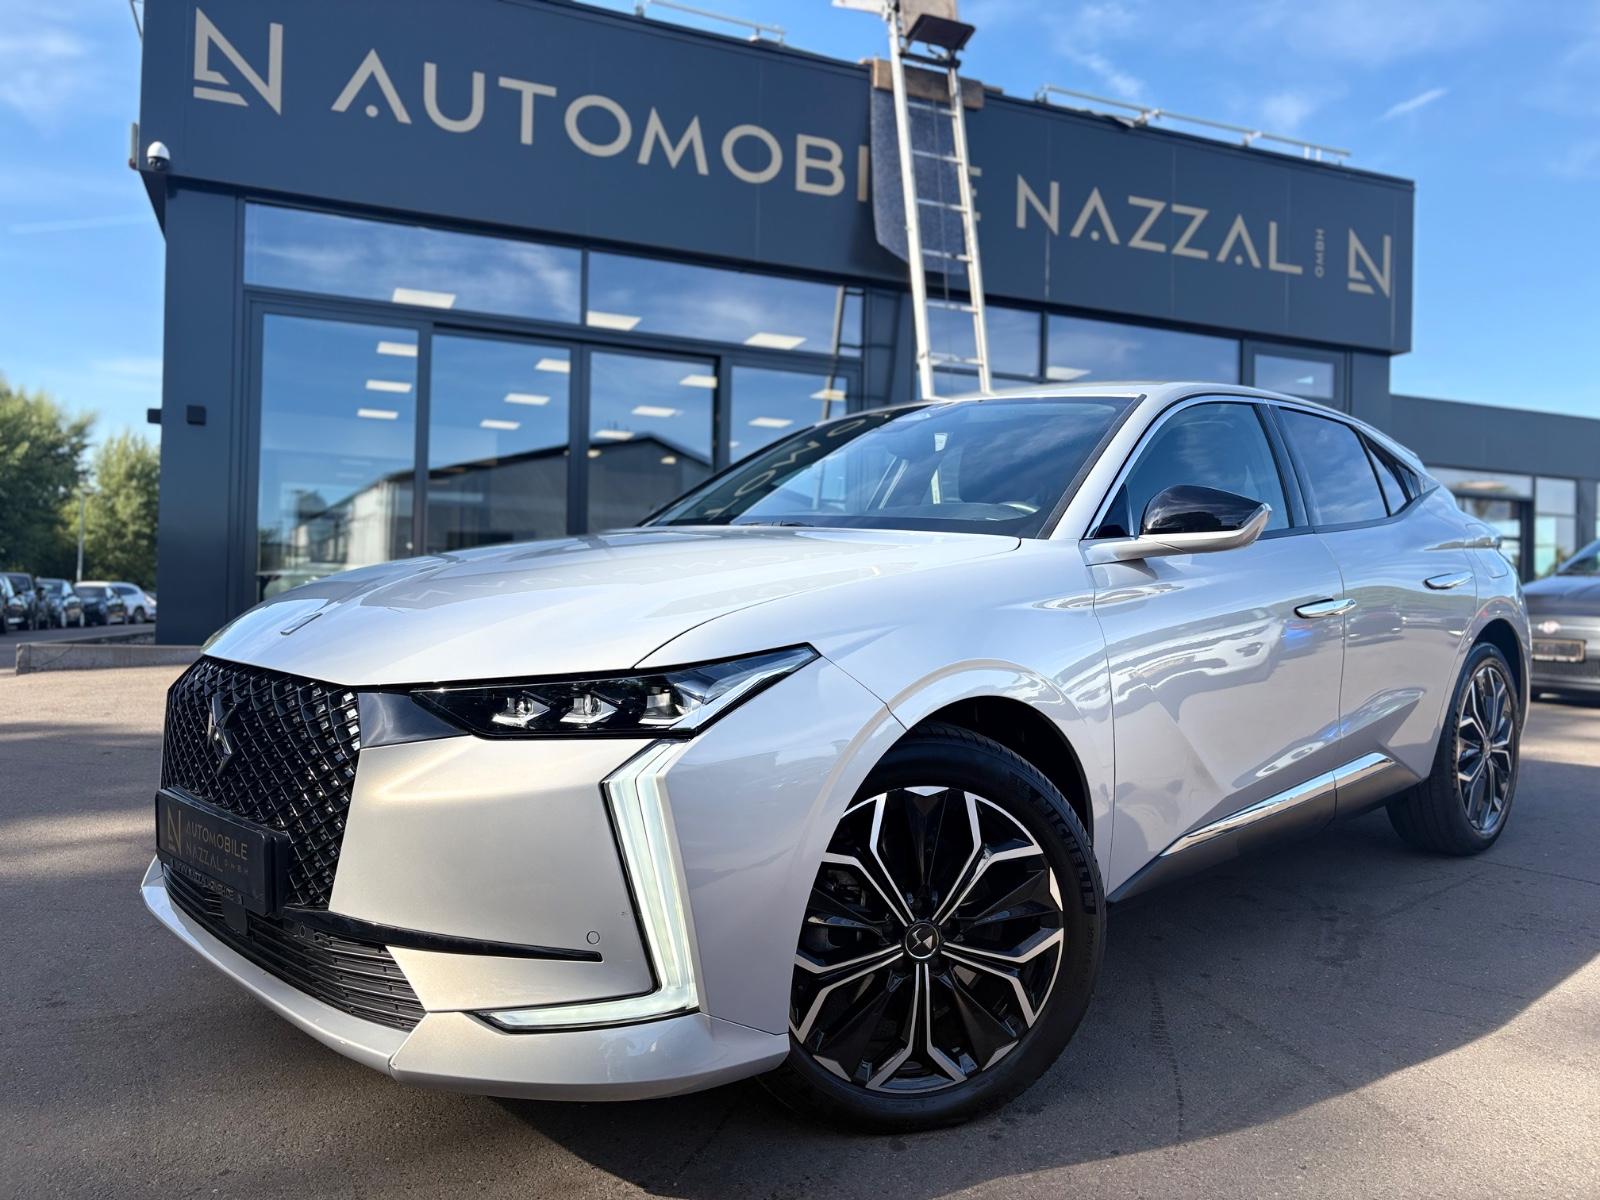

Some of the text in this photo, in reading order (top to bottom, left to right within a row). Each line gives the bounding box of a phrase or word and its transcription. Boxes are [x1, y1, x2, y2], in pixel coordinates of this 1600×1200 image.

[331, 48, 982, 222] AUTOMOBI
[1016, 174, 1302, 275] NAZZAL
[186, 821, 248, 860] AUTOMOBILE
[186, 842, 223, 873] NAZZAL
